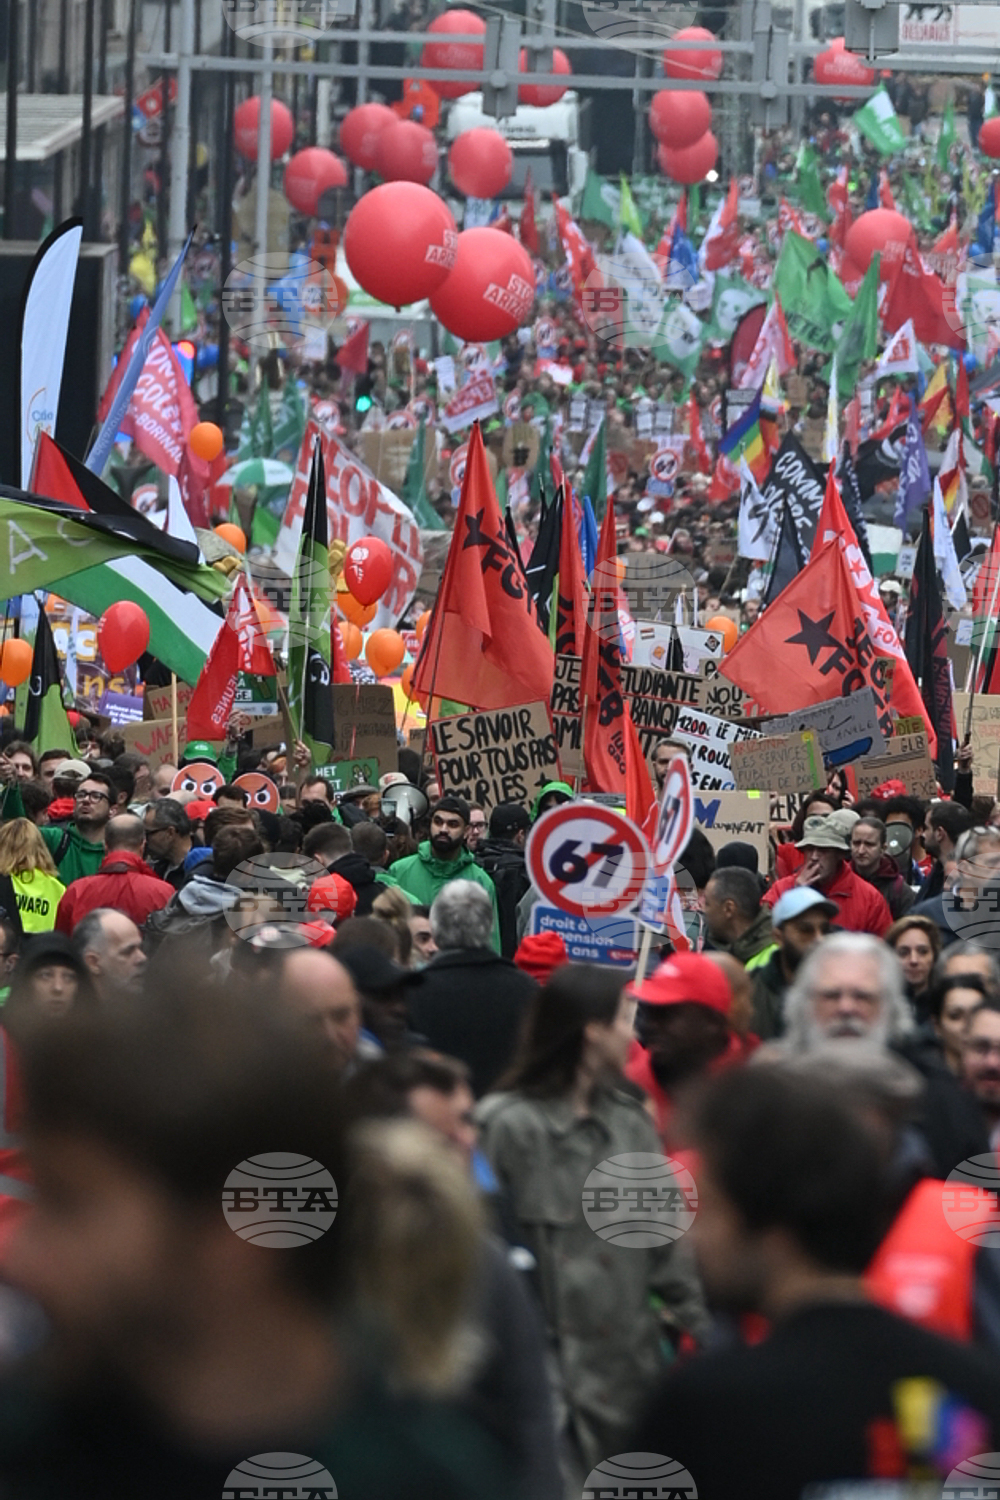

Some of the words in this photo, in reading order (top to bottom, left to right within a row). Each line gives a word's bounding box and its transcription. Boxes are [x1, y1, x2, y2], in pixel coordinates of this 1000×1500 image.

[619, 667, 703, 703] TUDIANTE
[432, 721, 457, 755] LE
[456, 708, 536, 751] SAVOIR
[716, 721, 732, 741] LE
[315, 766, 337, 778] HET
[438, 749, 483, 788] POUR
[481, 741, 529, 776] TOUS
[529, 733, 558, 770] PAS
[549, 838, 624, 889] 67
[540, 916, 573, 931] droit
[577, 918, 588, 932] à
[572, 947, 600, 959] ans
